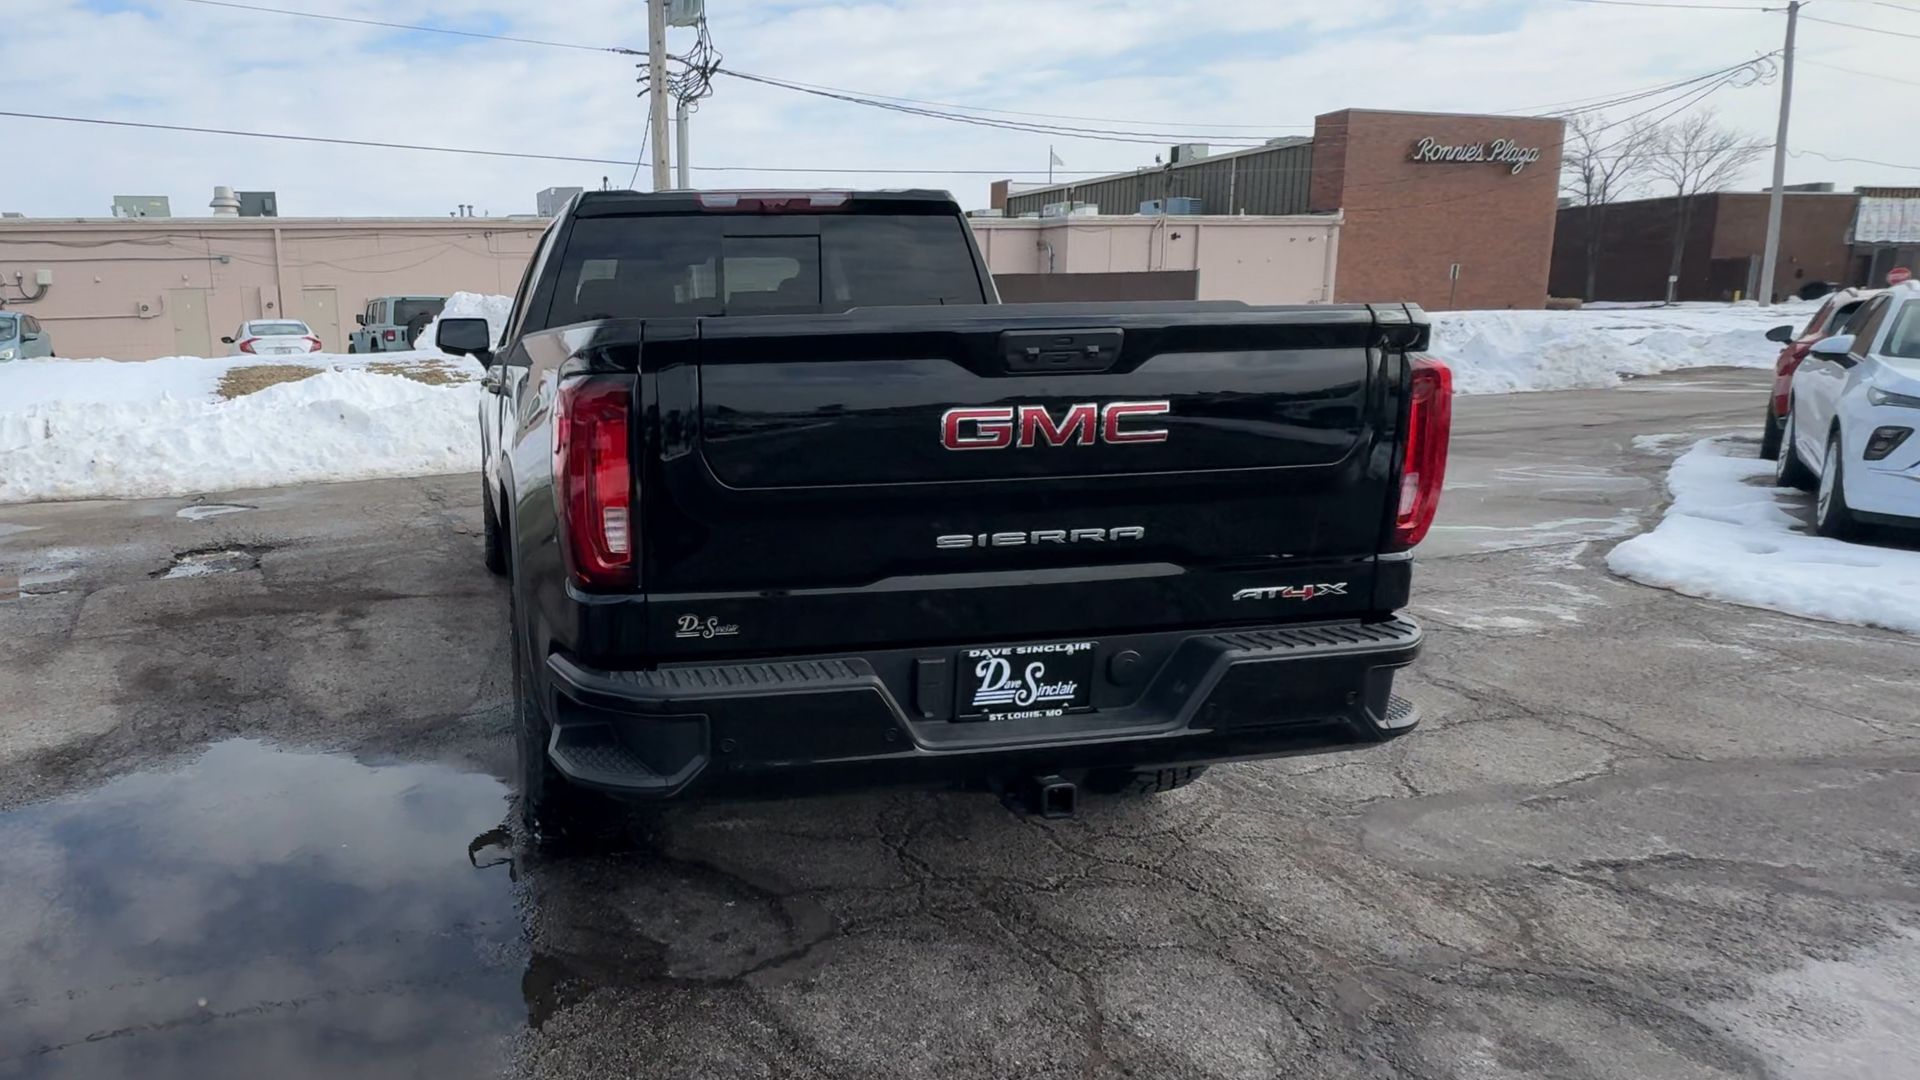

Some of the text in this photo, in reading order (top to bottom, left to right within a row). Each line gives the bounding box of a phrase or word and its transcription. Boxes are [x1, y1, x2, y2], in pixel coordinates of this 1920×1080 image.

[1413, 136, 1540, 175] Ronnie's Plaza
[941, 400, 1170, 450] GMC
[936, 526, 1145, 548] SIERRA
[1232, 582, 1348, 601] AT4X
[968, 642, 1091, 658] DAVE SINCLAIR
[975, 658, 1077, 706] Dave Sinclair
[988, 713, 1004, 721] ST.
[1046, 708, 1063, 717] MO
